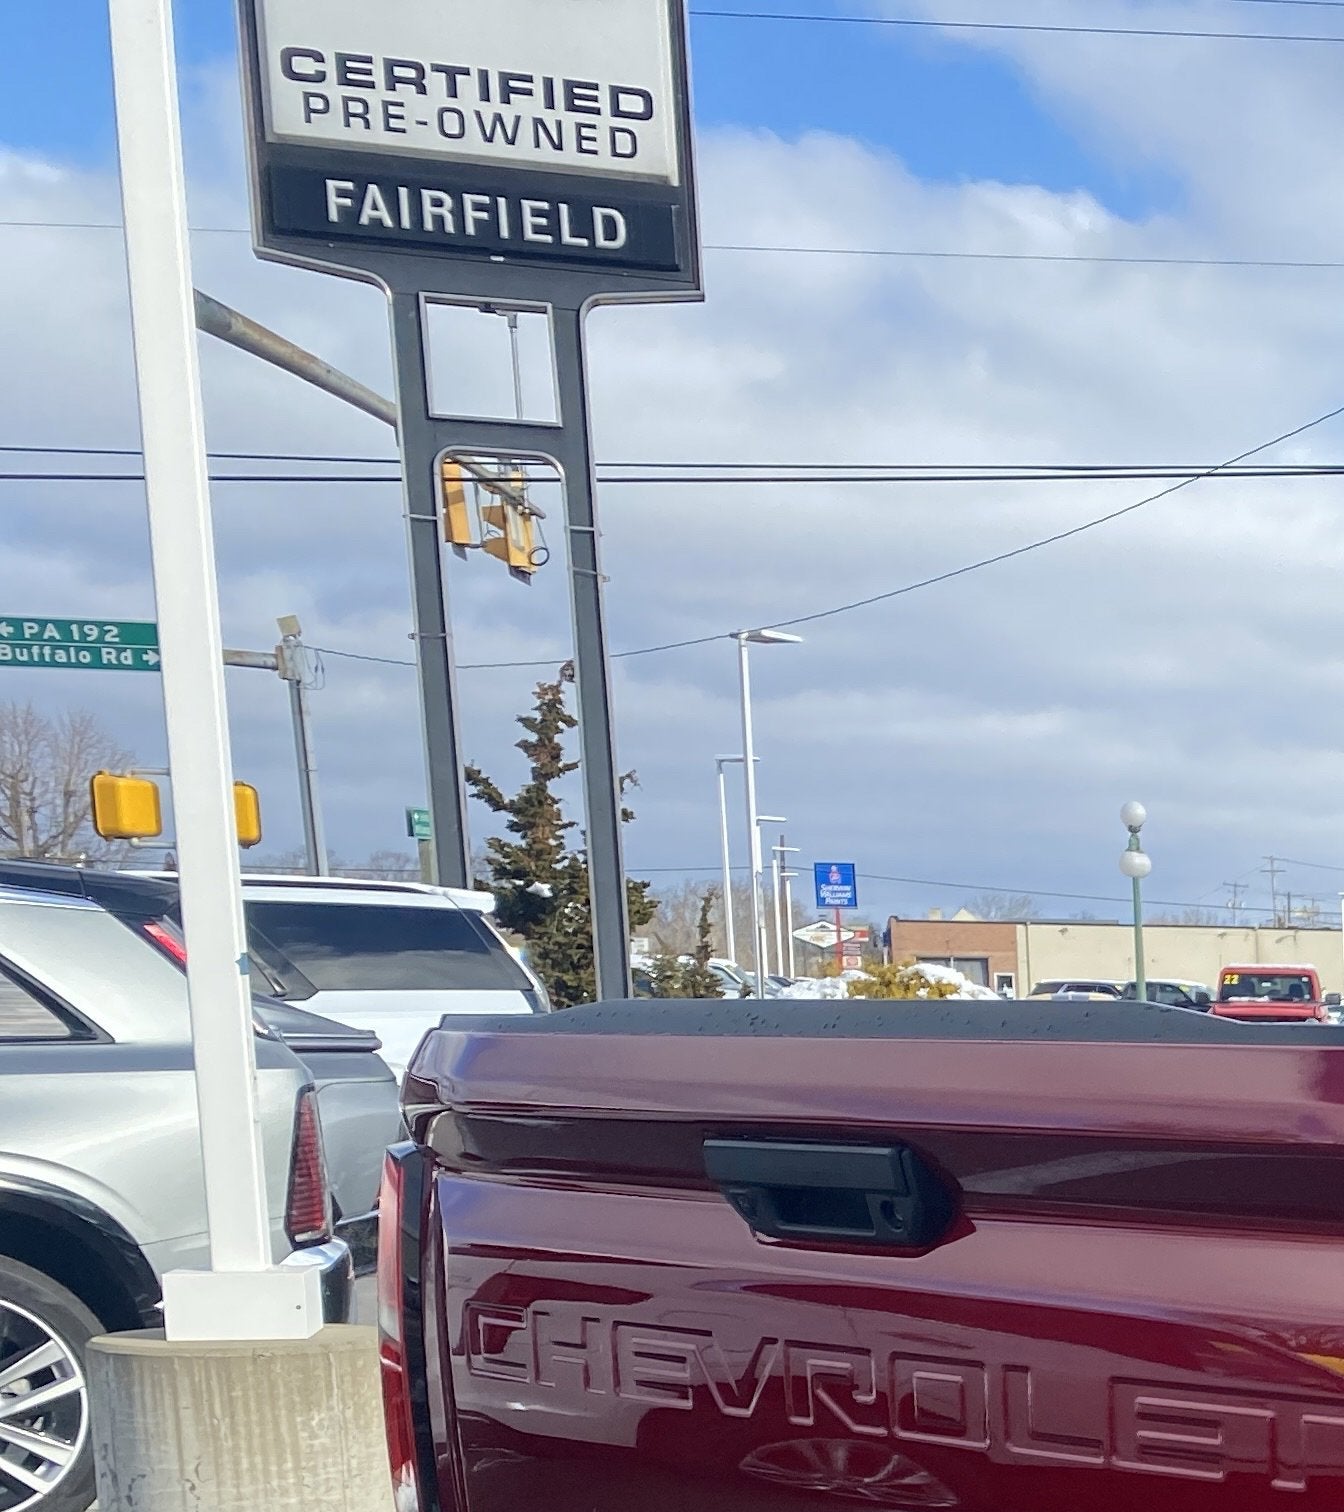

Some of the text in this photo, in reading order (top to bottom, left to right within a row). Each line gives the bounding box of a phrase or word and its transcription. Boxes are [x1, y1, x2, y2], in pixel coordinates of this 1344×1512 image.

[280, 46, 653, 121] CERTIFIED
[302, 91, 638, 159] PRE-OWNED
[324, 178, 627, 250] FAIRFIELD
[0, 643, 134, 666] Buffalo Rd
[22, 621, 120, 642] PA 192
